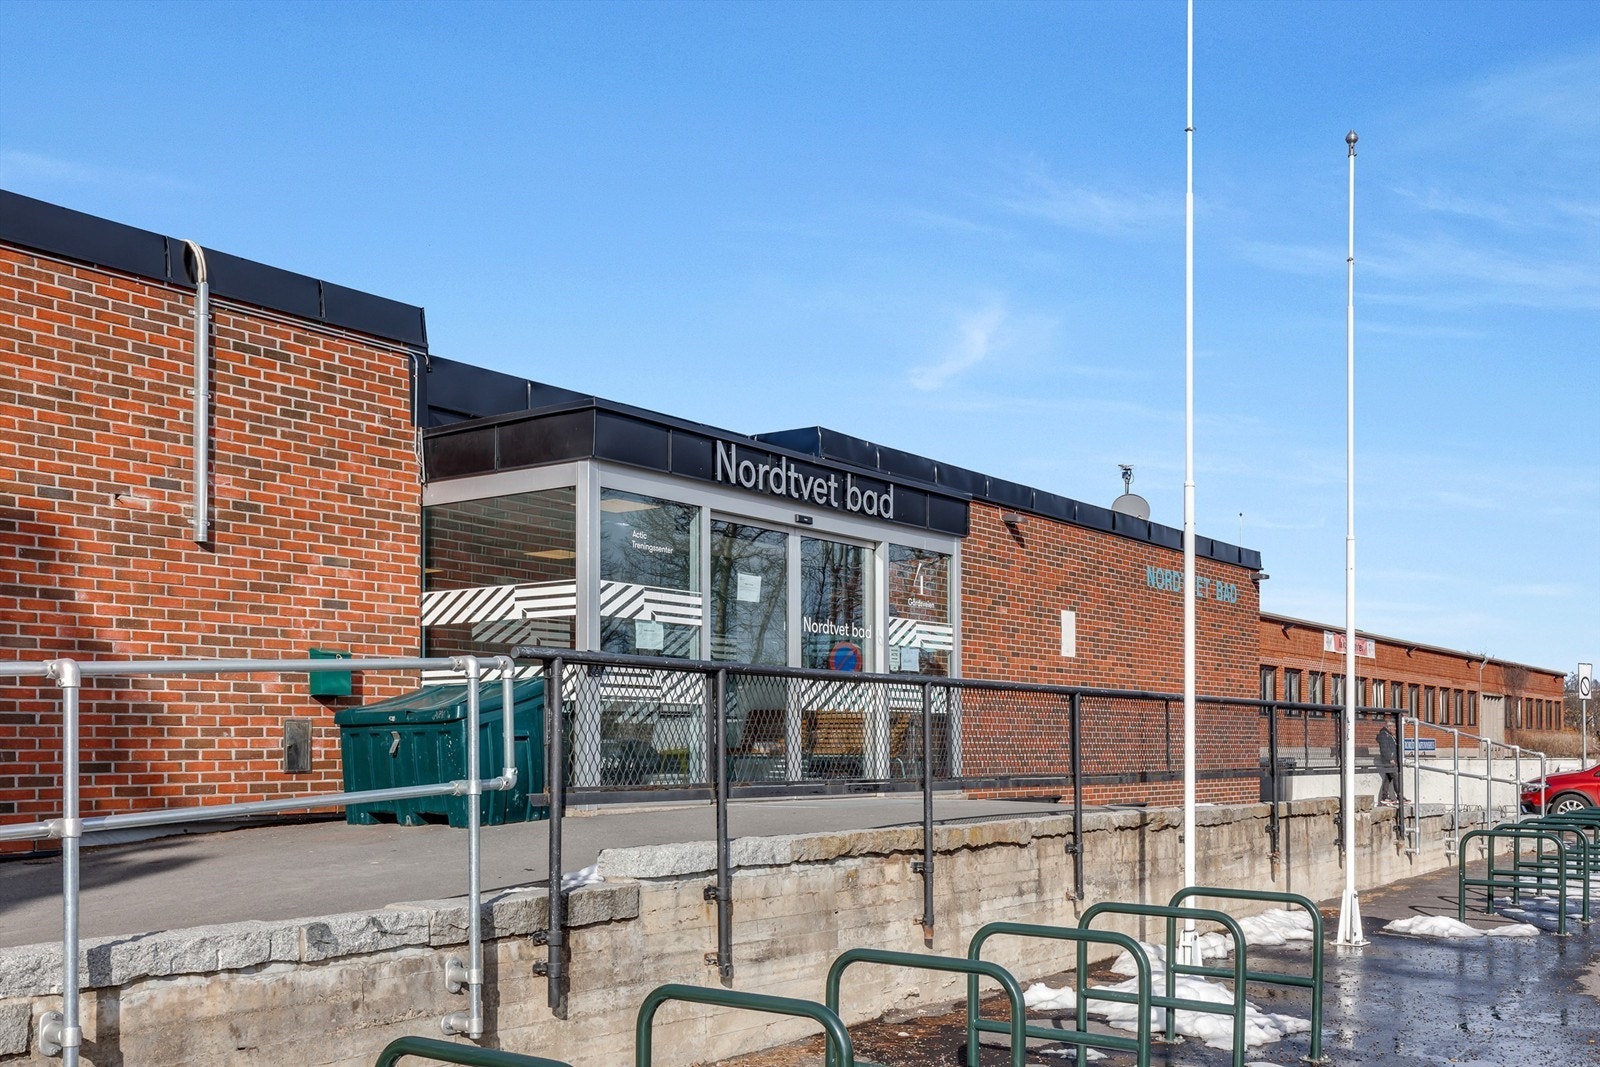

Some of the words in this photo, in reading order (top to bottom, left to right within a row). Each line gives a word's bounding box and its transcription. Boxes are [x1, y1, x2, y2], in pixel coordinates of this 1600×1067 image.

[716, 440, 838, 508] Nordtvet
[846, 473, 894, 520] bad
[632, 530, 648, 540] Actic
[632, 540, 674, 554] Treningssenter
[1146, 565, 1210, 599] NORDET
[1216, 580, 1237, 604] BAD
[803, 616, 850, 637] Nordtvet
[851, 622, 872, 640] bad
